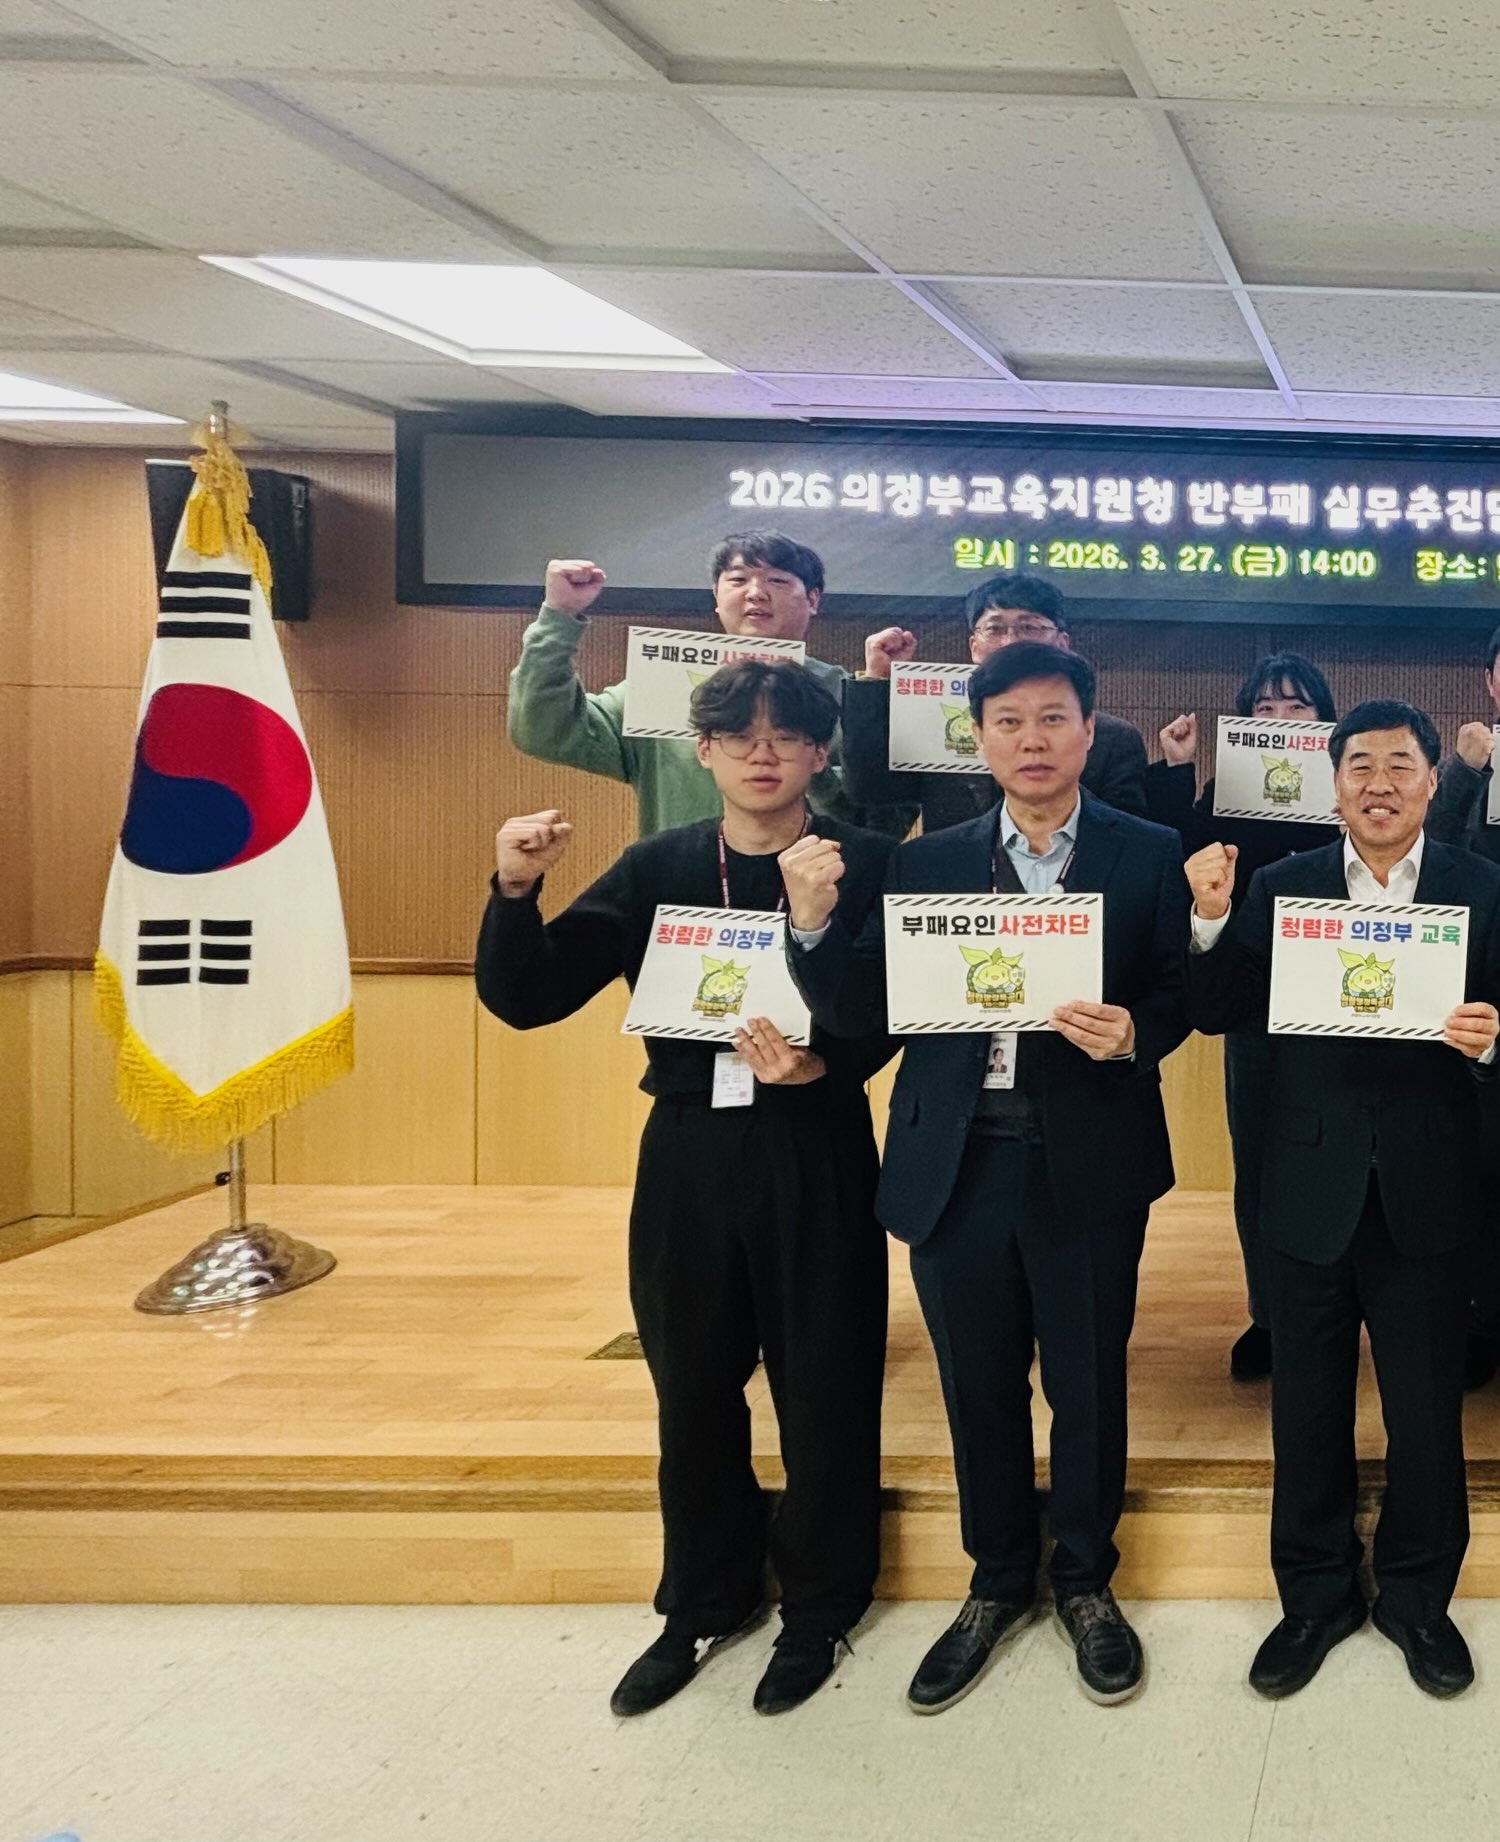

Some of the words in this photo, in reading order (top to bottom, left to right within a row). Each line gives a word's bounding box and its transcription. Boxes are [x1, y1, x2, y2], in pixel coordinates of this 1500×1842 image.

[729, 470, 834, 508] 2026
[840, 472, 1173, 525] 의정부교육지원청
[1188, 481, 1309, 526] 반부패
[953, 537, 1015, 570] 일시
[1048, 541, 1129, 570] 2026.
[1140, 544, 1166, 571] 3.
[1178, 546, 1223, 573] 27.
[1231, 544, 1289, 577] (금)
[1298, 549, 1376, 577] 14:00
[1415, 551, 1487, 582] 장소:
[896, 677, 944, 696] 청렴한
[656, 923, 713, 946] 청렴한
[717, 928, 774, 950] 의정부
[1281, 916, 1343, 940] 청렴한
[1350, 920, 1413, 943] 의정부
[1420, 923, 1461, 946] 교육
